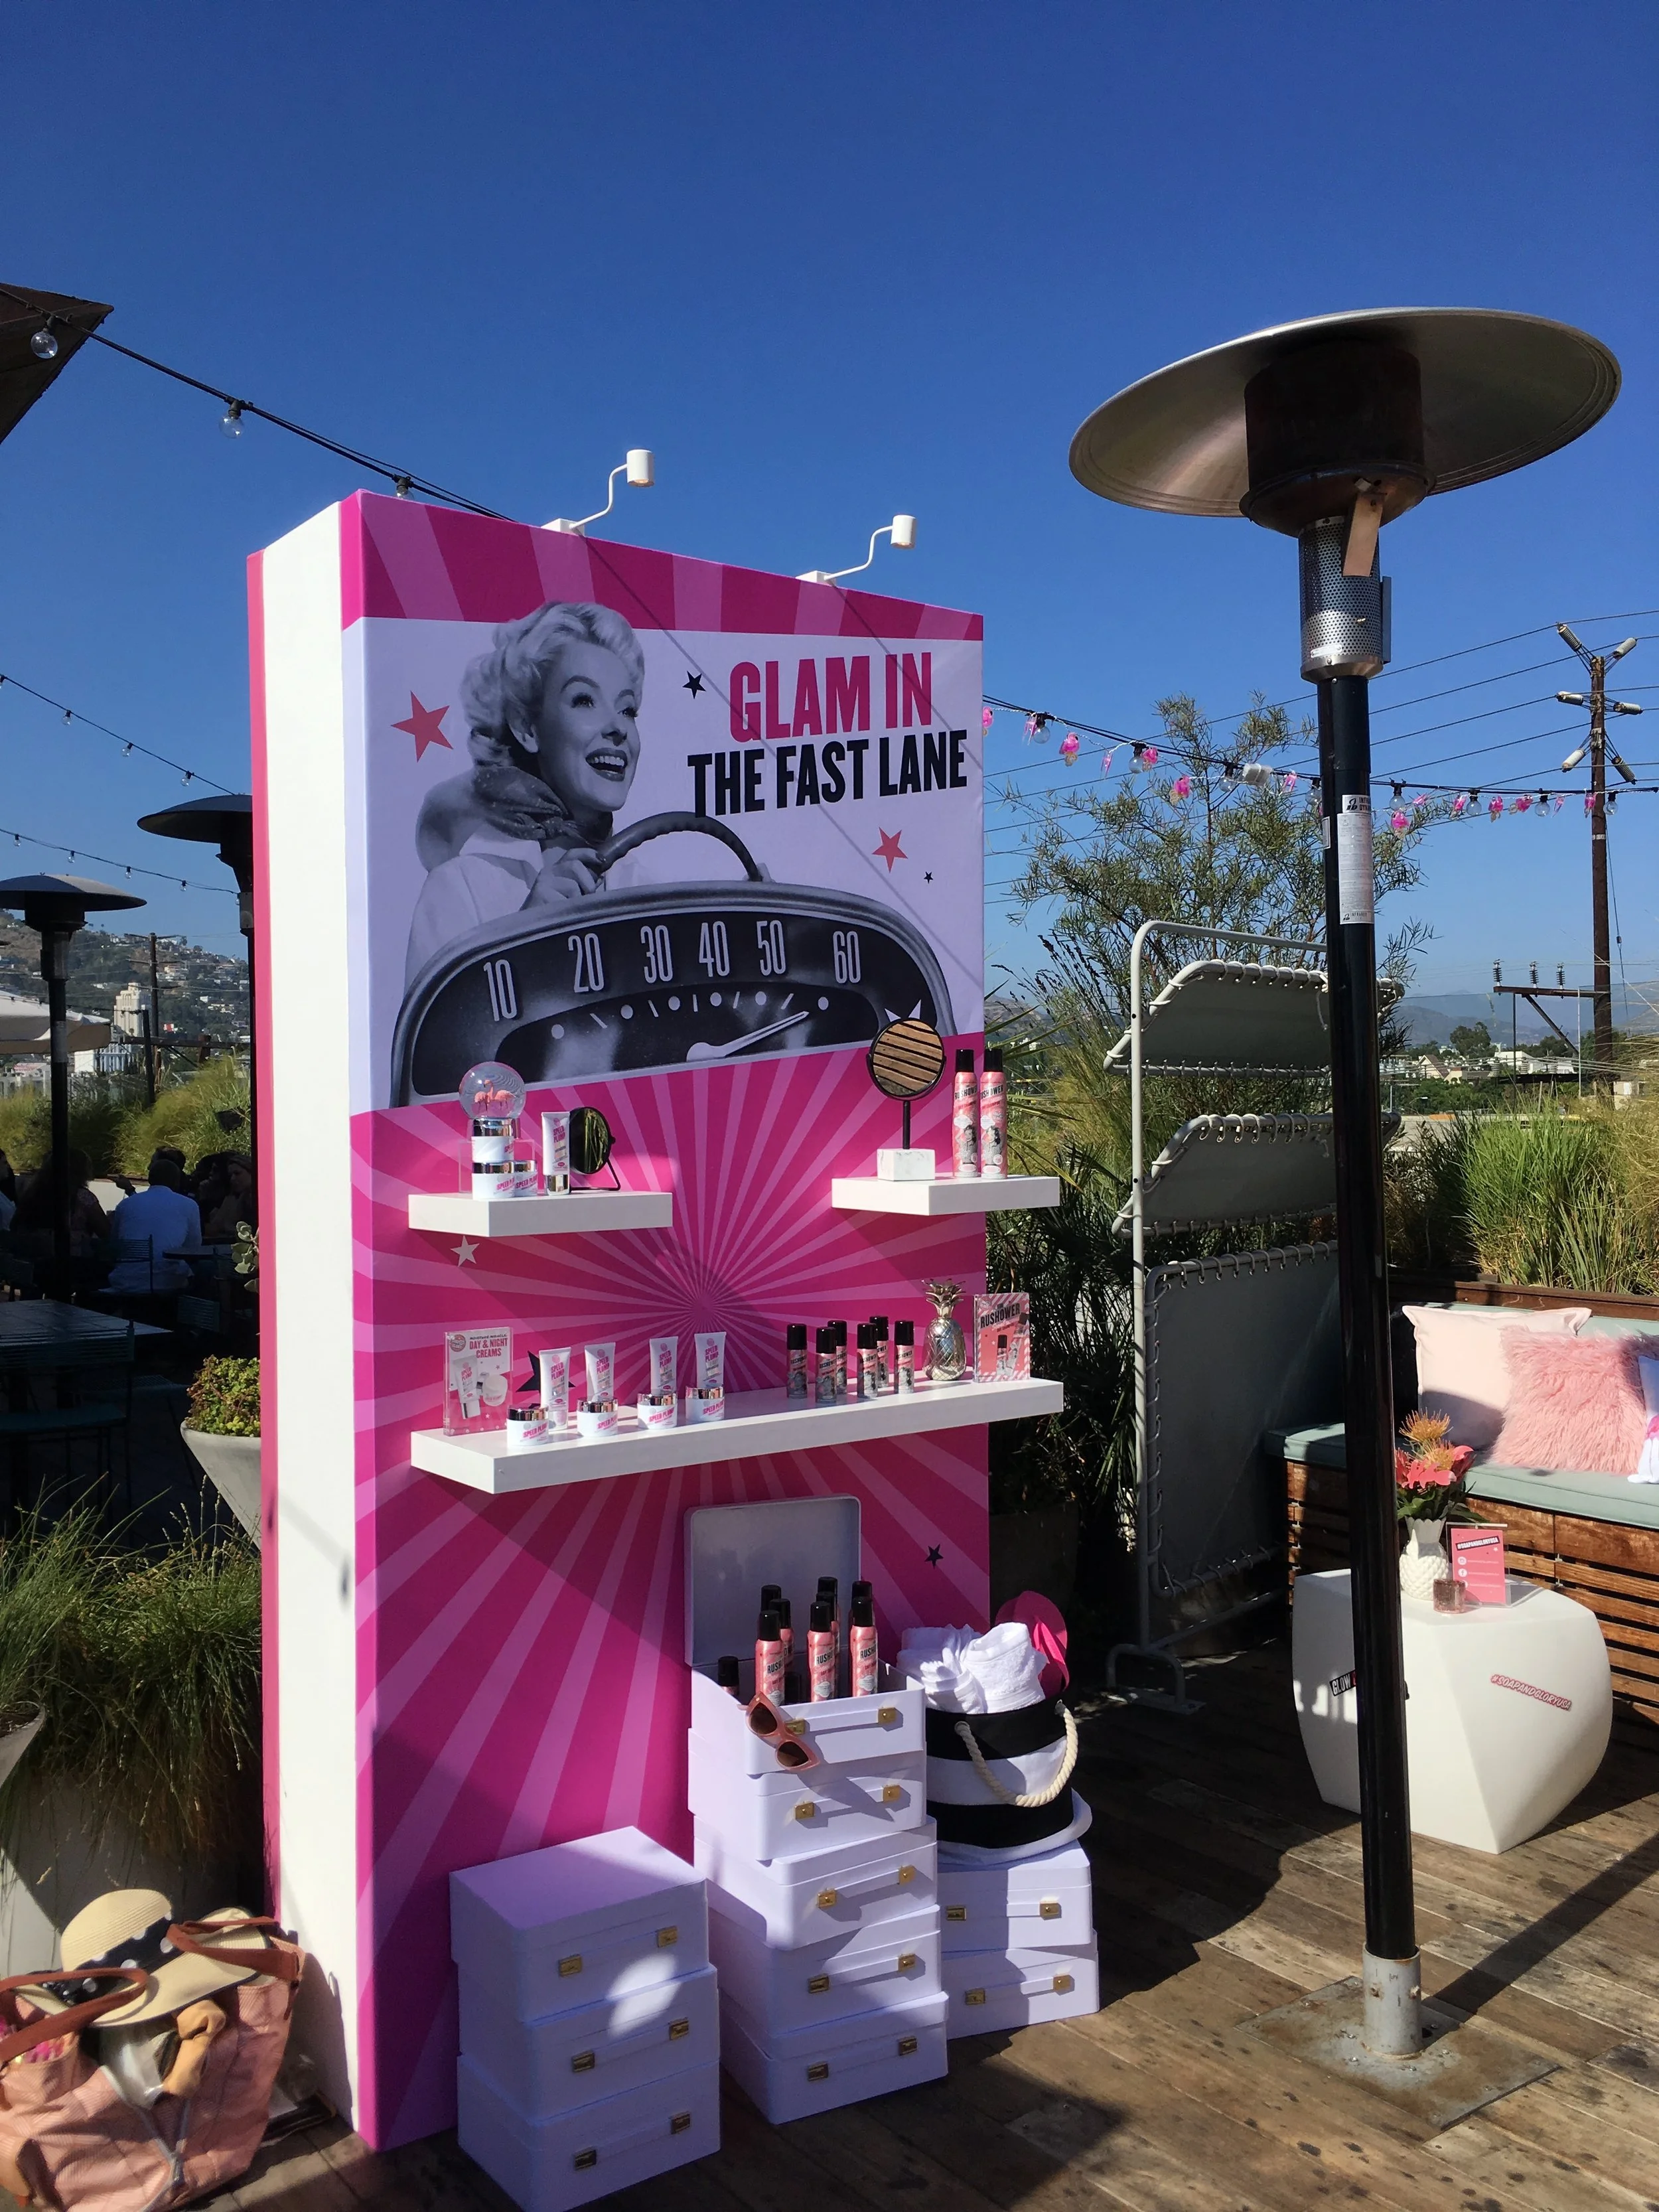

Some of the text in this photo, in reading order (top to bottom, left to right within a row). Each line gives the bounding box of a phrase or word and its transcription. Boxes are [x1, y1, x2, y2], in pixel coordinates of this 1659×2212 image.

[730, 652, 932, 743] GLAM IN
[687, 729, 967, 818] THE FAST LANE
[483, 920, 861, 1021] 10 20 30 40 50 60
[553, 1126, 565, 1136] SPEED
[516, 1179, 528, 1189] SPEED
[980, 1303, 1021, 1329] RUSHOWER
[469, 1340, 481, 1350] DAY
[482, 1339, 488, 1349] &
[490, 1338, 508, 1347] NIGHT
[476, 1348, 502, 1359] CREAMS
[659, 1350, 672, 1361] SPEED
[705, 1345, 718, 1356] SPEED
[597, 1356, 609, 1367] SPEED
[660, 1356, 672, 1368] PLUMP
[705, 1351, 719, 1363] PLUMP
[551, 1362, 564, 1373] SPEED
[597, 1363, 609, 1374] PLUMP
[551, 1368, 565, 1380] PLUMP
[703, 1405, 715, 1415] SPEED
[649, 1413, 662, 1422] SPEED
[598, 1420, 610, 1429] SPEED
[523, 1426, 537, 1438] SPEED
[1332, 1673, 1351, 1695] GLOW
[1490, 1674, 1572, 1710] #SOAPANDGLORYUSA
